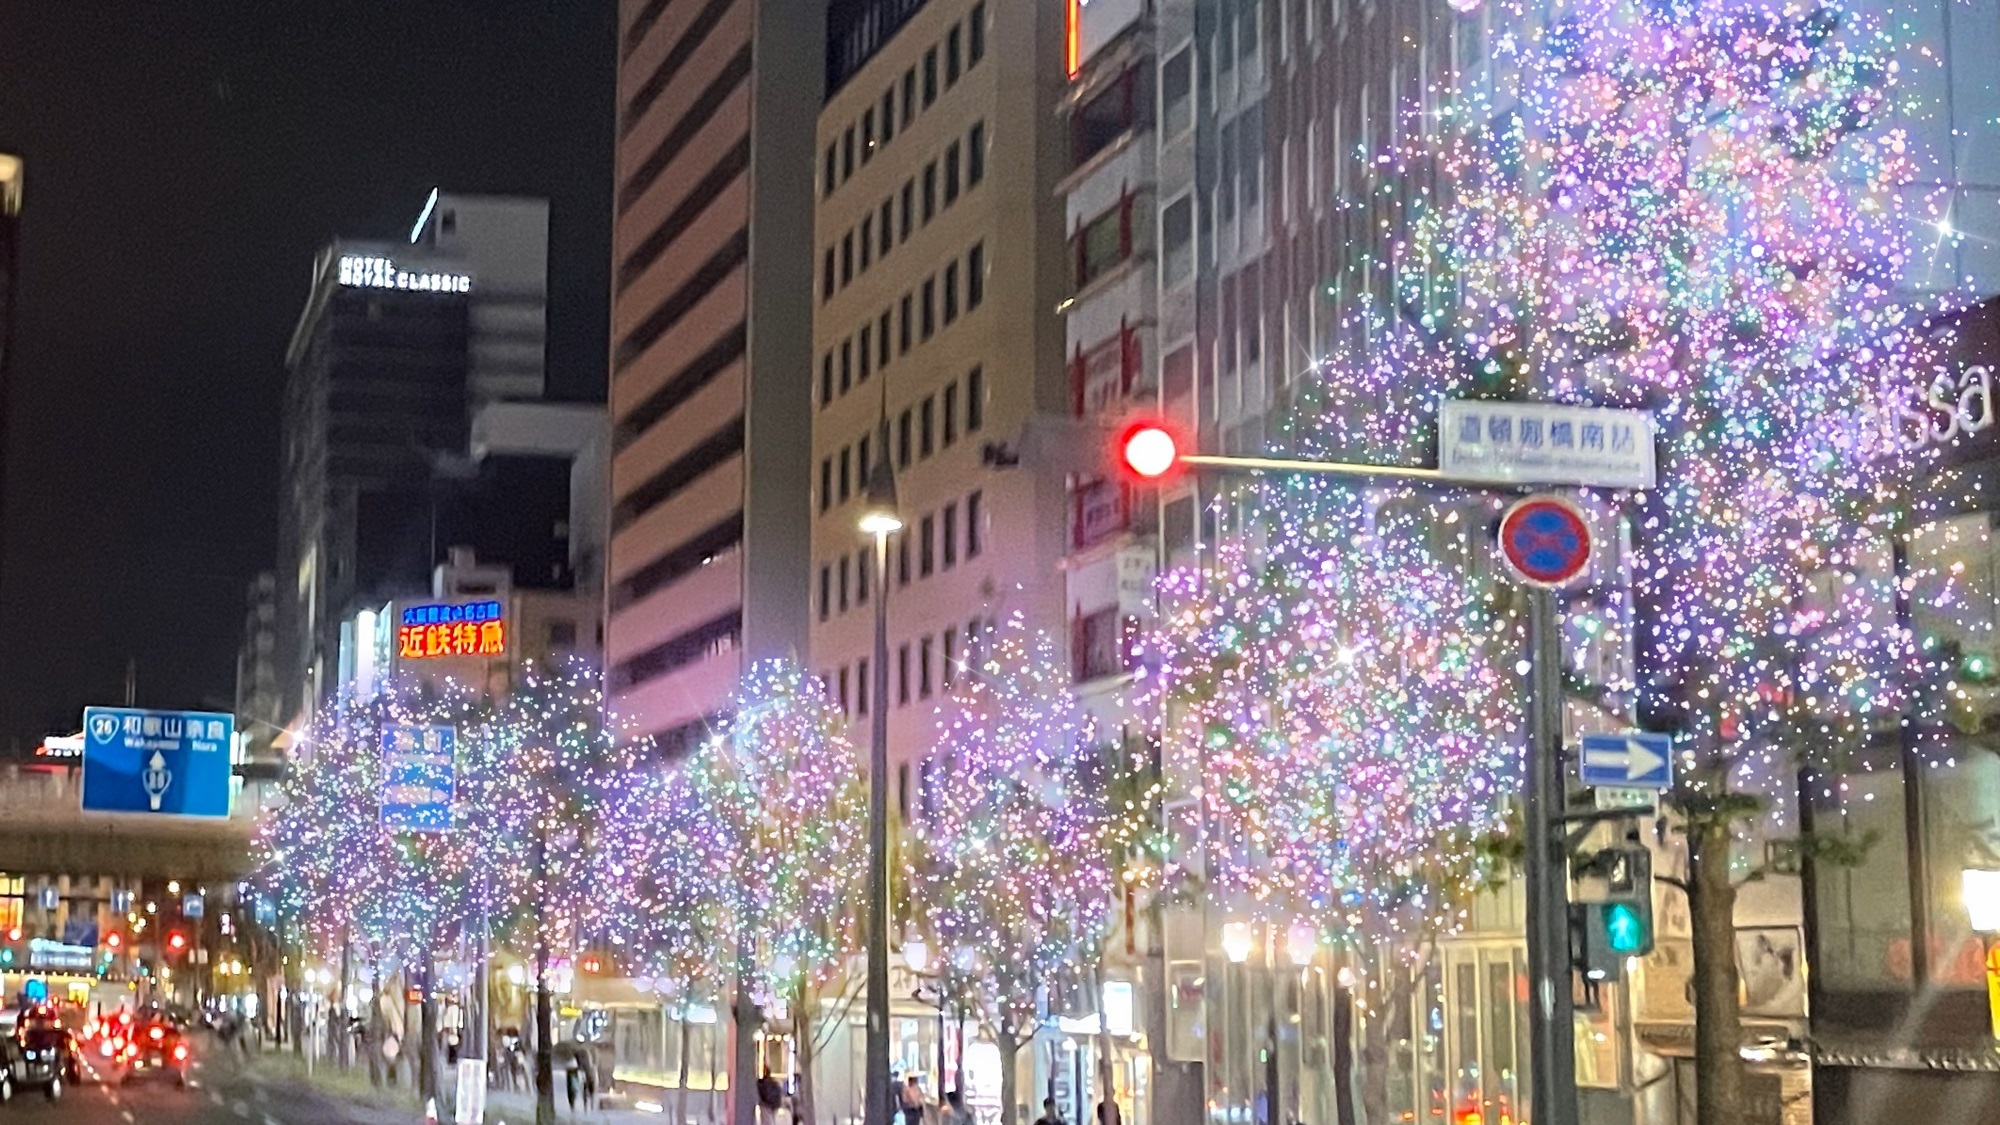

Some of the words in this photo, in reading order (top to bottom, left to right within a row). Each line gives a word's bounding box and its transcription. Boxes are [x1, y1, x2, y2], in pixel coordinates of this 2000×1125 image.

[397, 272, 471, 293] CLASSIC
[399, 620, 504, 658] 近鉄特急
[124, 738, 180, 750] Waka
